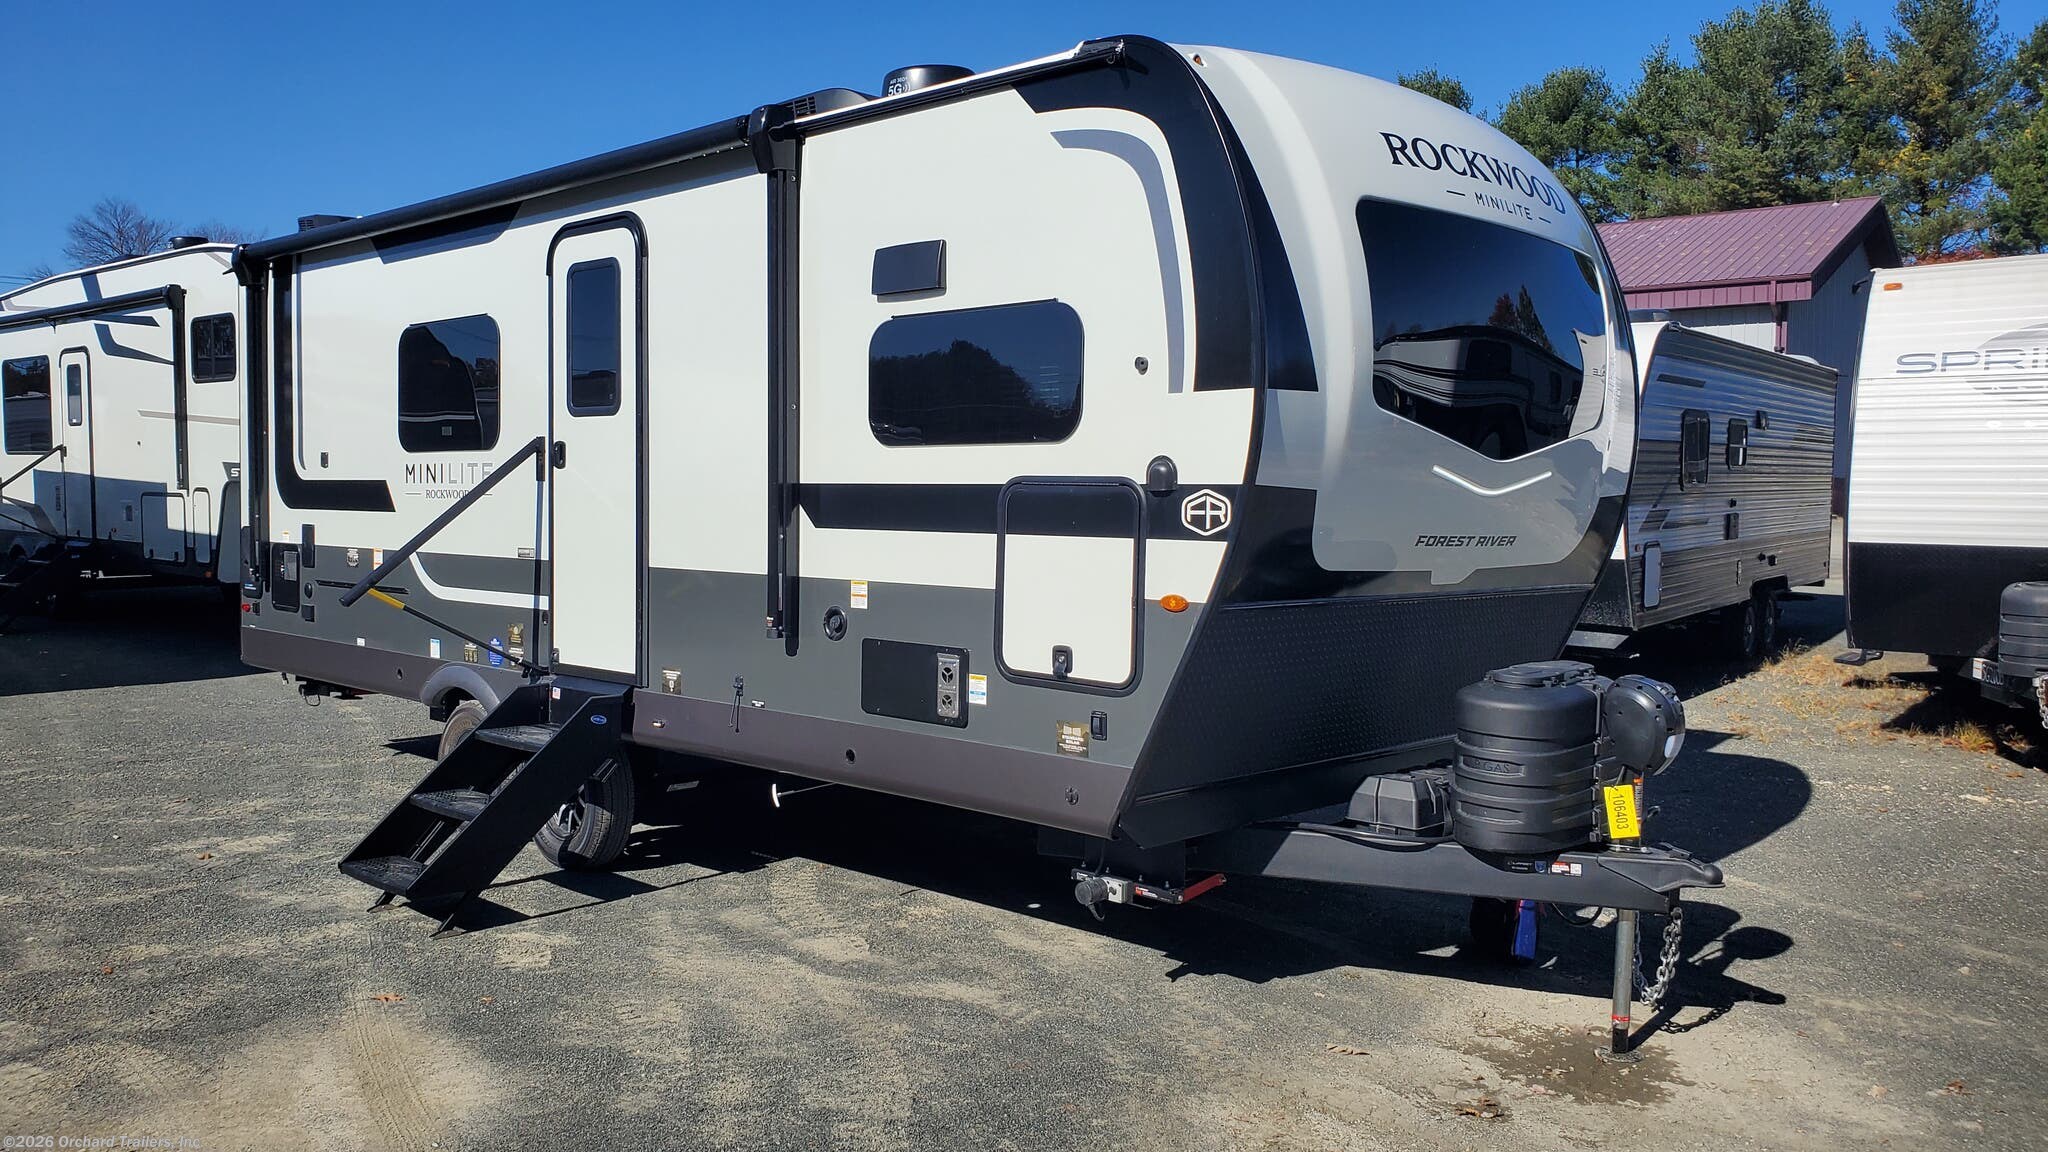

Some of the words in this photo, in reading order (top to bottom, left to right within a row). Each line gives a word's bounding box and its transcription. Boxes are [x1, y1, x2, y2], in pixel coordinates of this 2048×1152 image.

[887, 83, 902, 96] 5G
[1378, 131, 1567, 215] ROCKWOOD
[1474, 191, 1533, 220] MINILITE
[1896, 348, 2048, 374] SPRI
[405, 462, 493, 484] MINILITE
[1414, 535, 1476, 547] FOREST
[1475, 535, 1518, 547] RIVER
[1612, 794, 1630, 830] 106403
